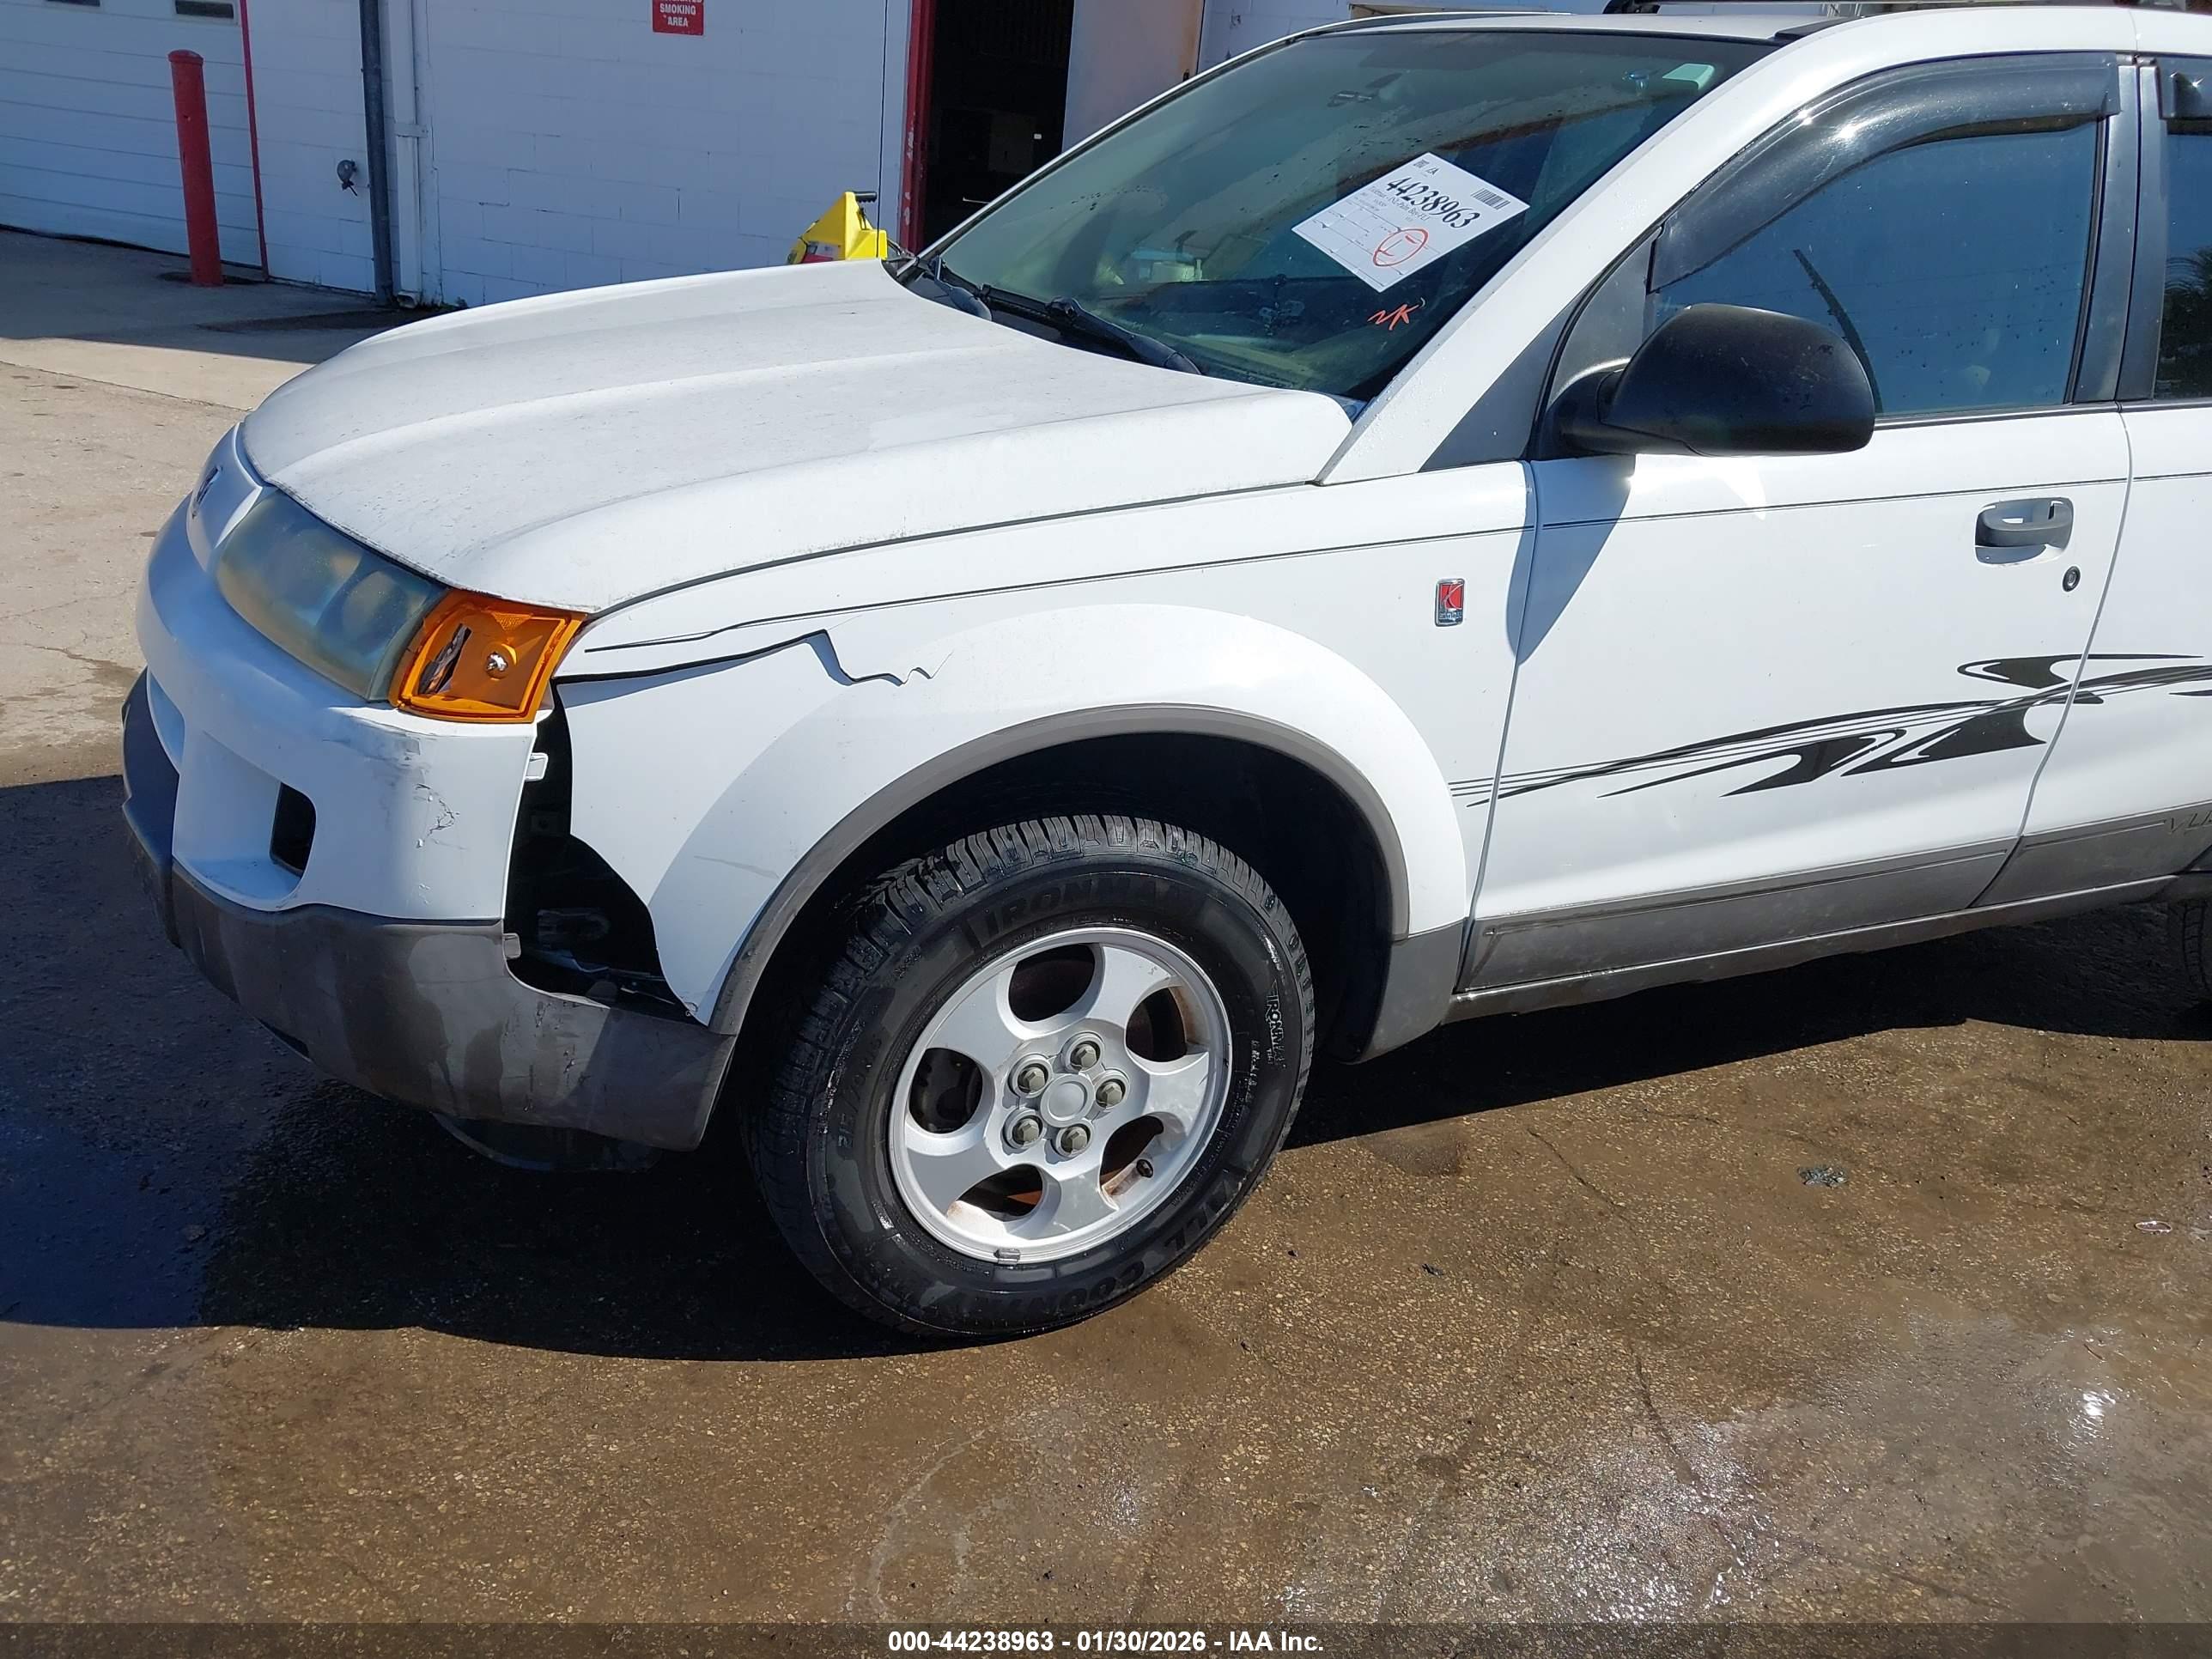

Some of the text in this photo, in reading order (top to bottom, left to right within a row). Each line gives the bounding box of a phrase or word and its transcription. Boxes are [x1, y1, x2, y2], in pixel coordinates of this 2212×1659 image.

[659, 3, 696, 15] SMOKING
[667, 16, 689, 27] AREA
[1387, 177, 1480, 228] 44238963
